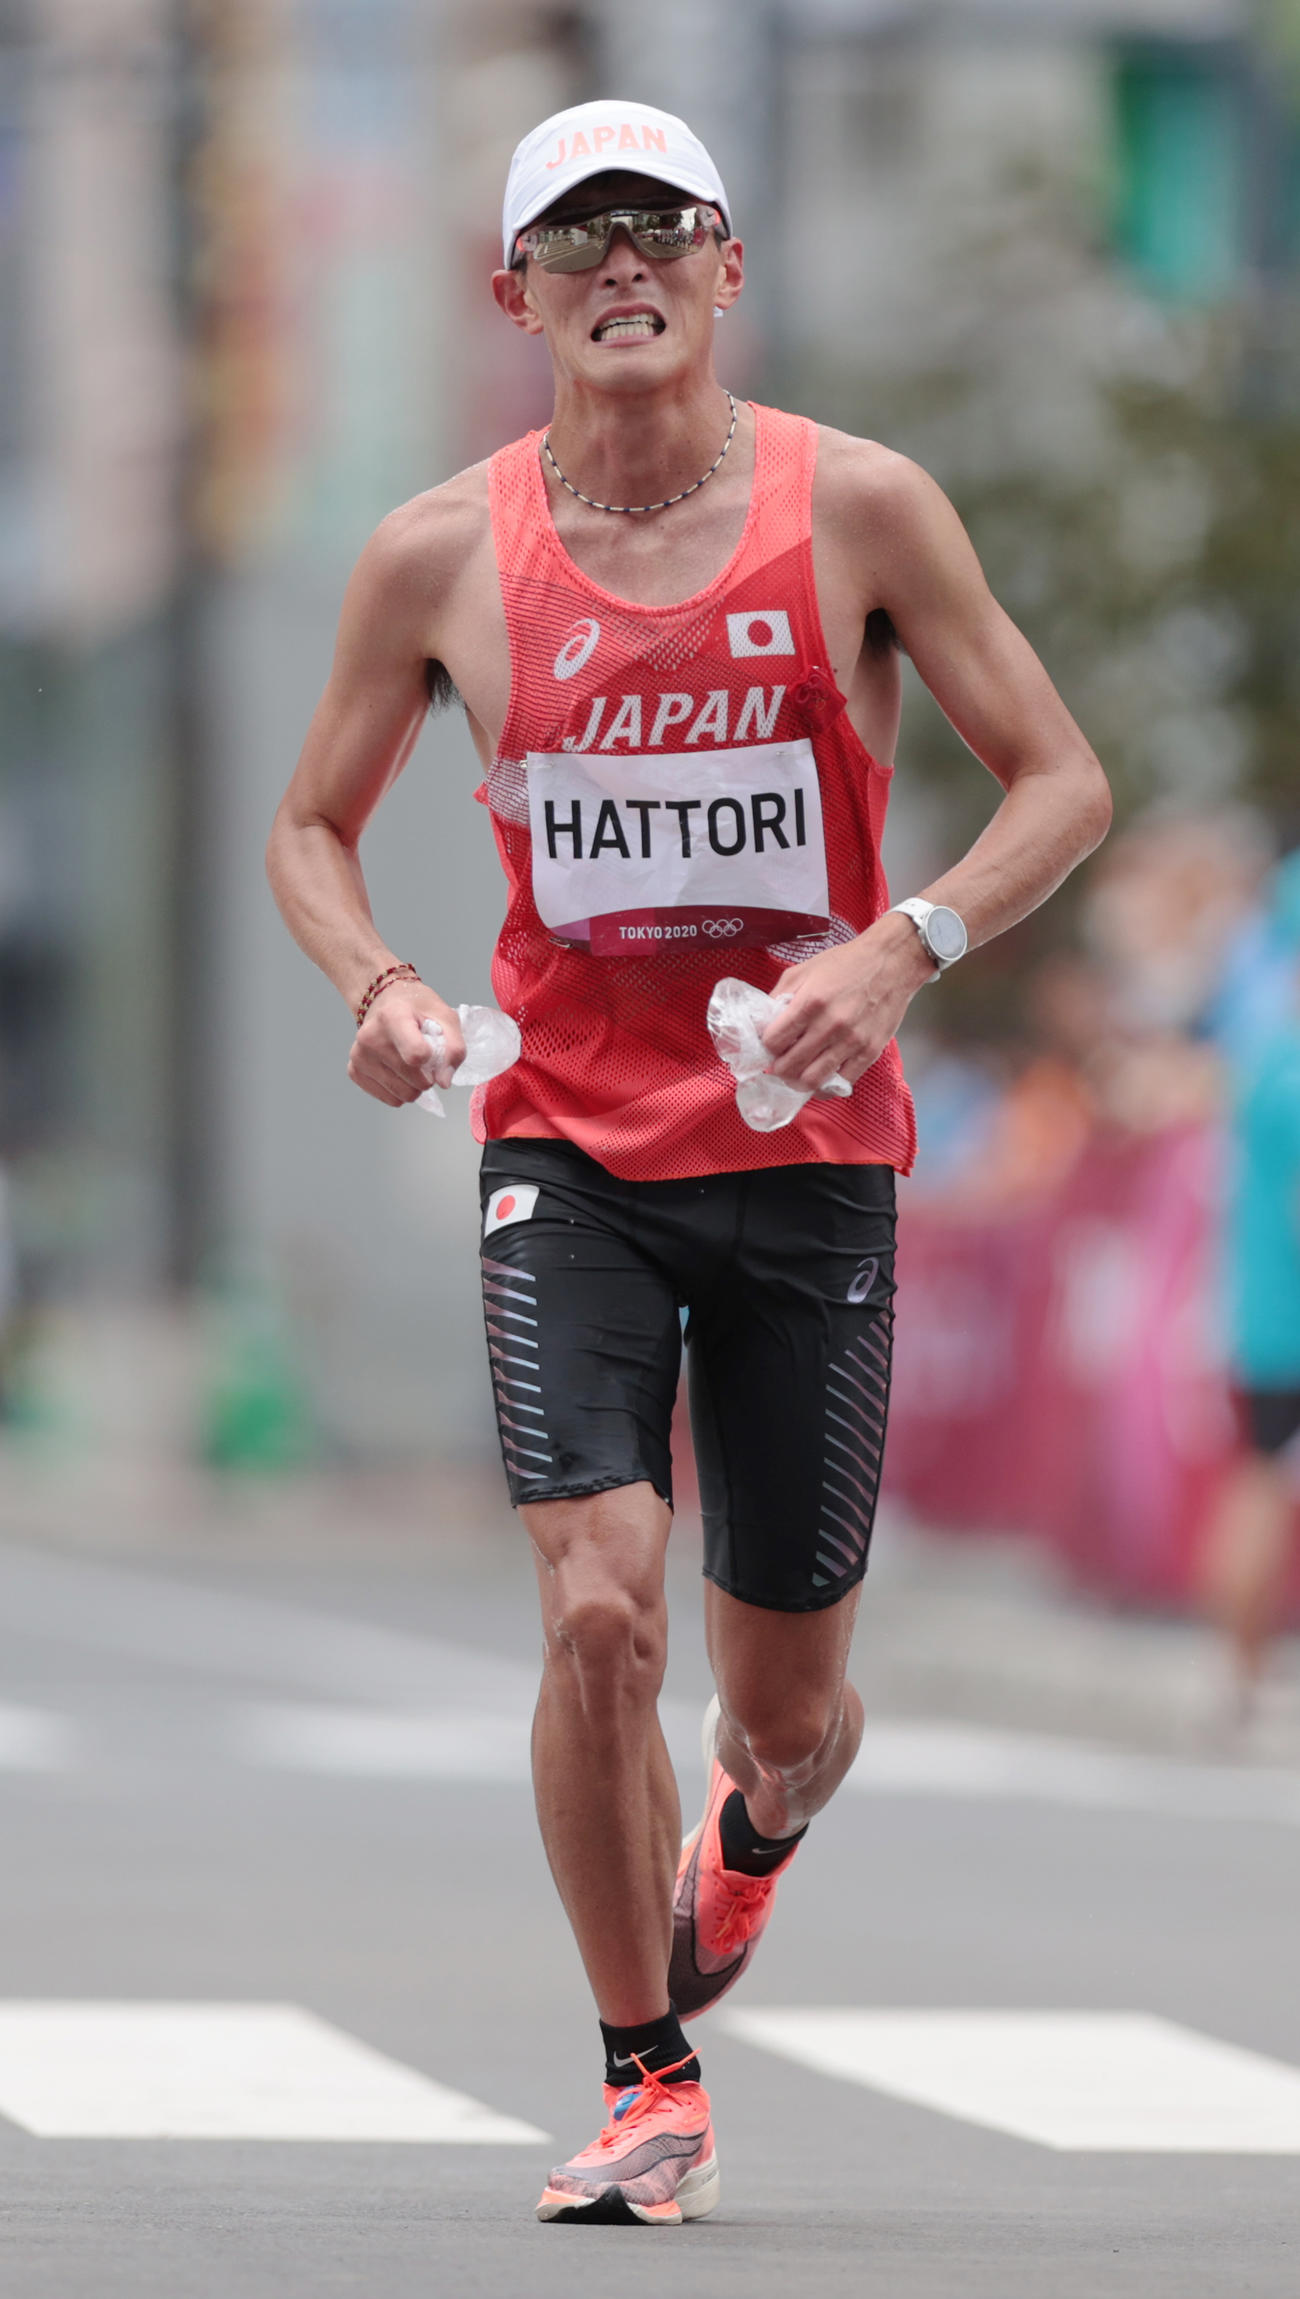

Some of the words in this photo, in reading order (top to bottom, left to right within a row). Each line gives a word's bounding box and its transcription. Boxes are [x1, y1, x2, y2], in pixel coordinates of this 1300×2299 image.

[546, 124, 667, 169] JAPAN
[562, 685, 787, 753] JAPAN
[544, 788, 806, 859] HATTORI
[619, 926, 662, 940] TOKYO
[664, 924, 697, 939] 2020
